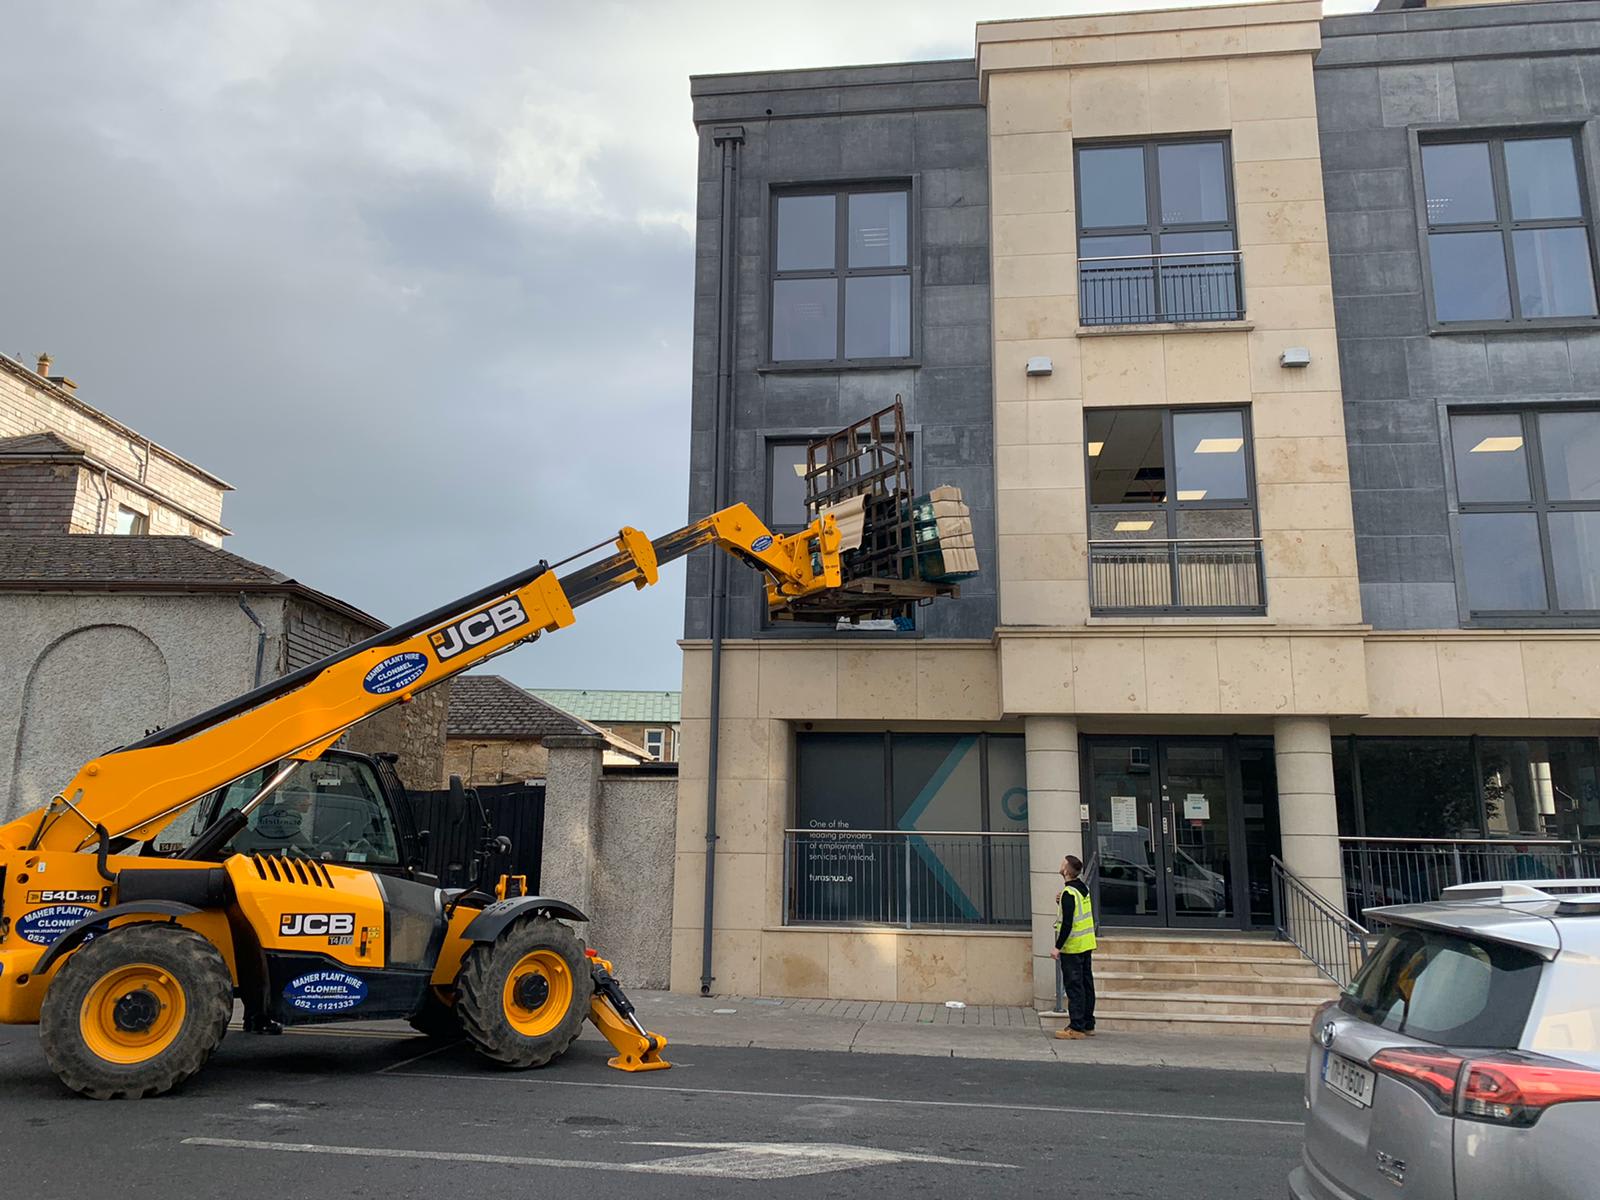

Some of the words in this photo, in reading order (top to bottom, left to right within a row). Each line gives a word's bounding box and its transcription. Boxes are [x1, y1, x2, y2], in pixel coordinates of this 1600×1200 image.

[437, 599, 525, 658] JCB
[366, 663, 385, 682] MAHER
[384, 654, 404, 667] PLANT
[377, 662, 413, 681] CLONMEL
[377, 686, 391, 694] 052
[395, 669, 424, 688] 6121333
[809, 819, 826, 828] One
[828, 819, 836, 828] of
[838, 820, 850, 828] the
[819, 842, 864, 851] employment
[809, 853, 837, 861] services
[839, 853, 847, 861] in
[24, 907, 55, 923] MAHER
[56, 906, 83, 915] PLANT
[281, 915, 353, 935] JCB
[27, 934, 45, 943] 052
[292, 973, 320, 988] MAHER
[321, 972, 345, 982] PLANT
[345, 975, 362, 989] HIRE
[304, 985, 348, 993] CLONMEL
[294, 999, 311, 1009] 052
[317, 999, 354, 1010] 6121333
